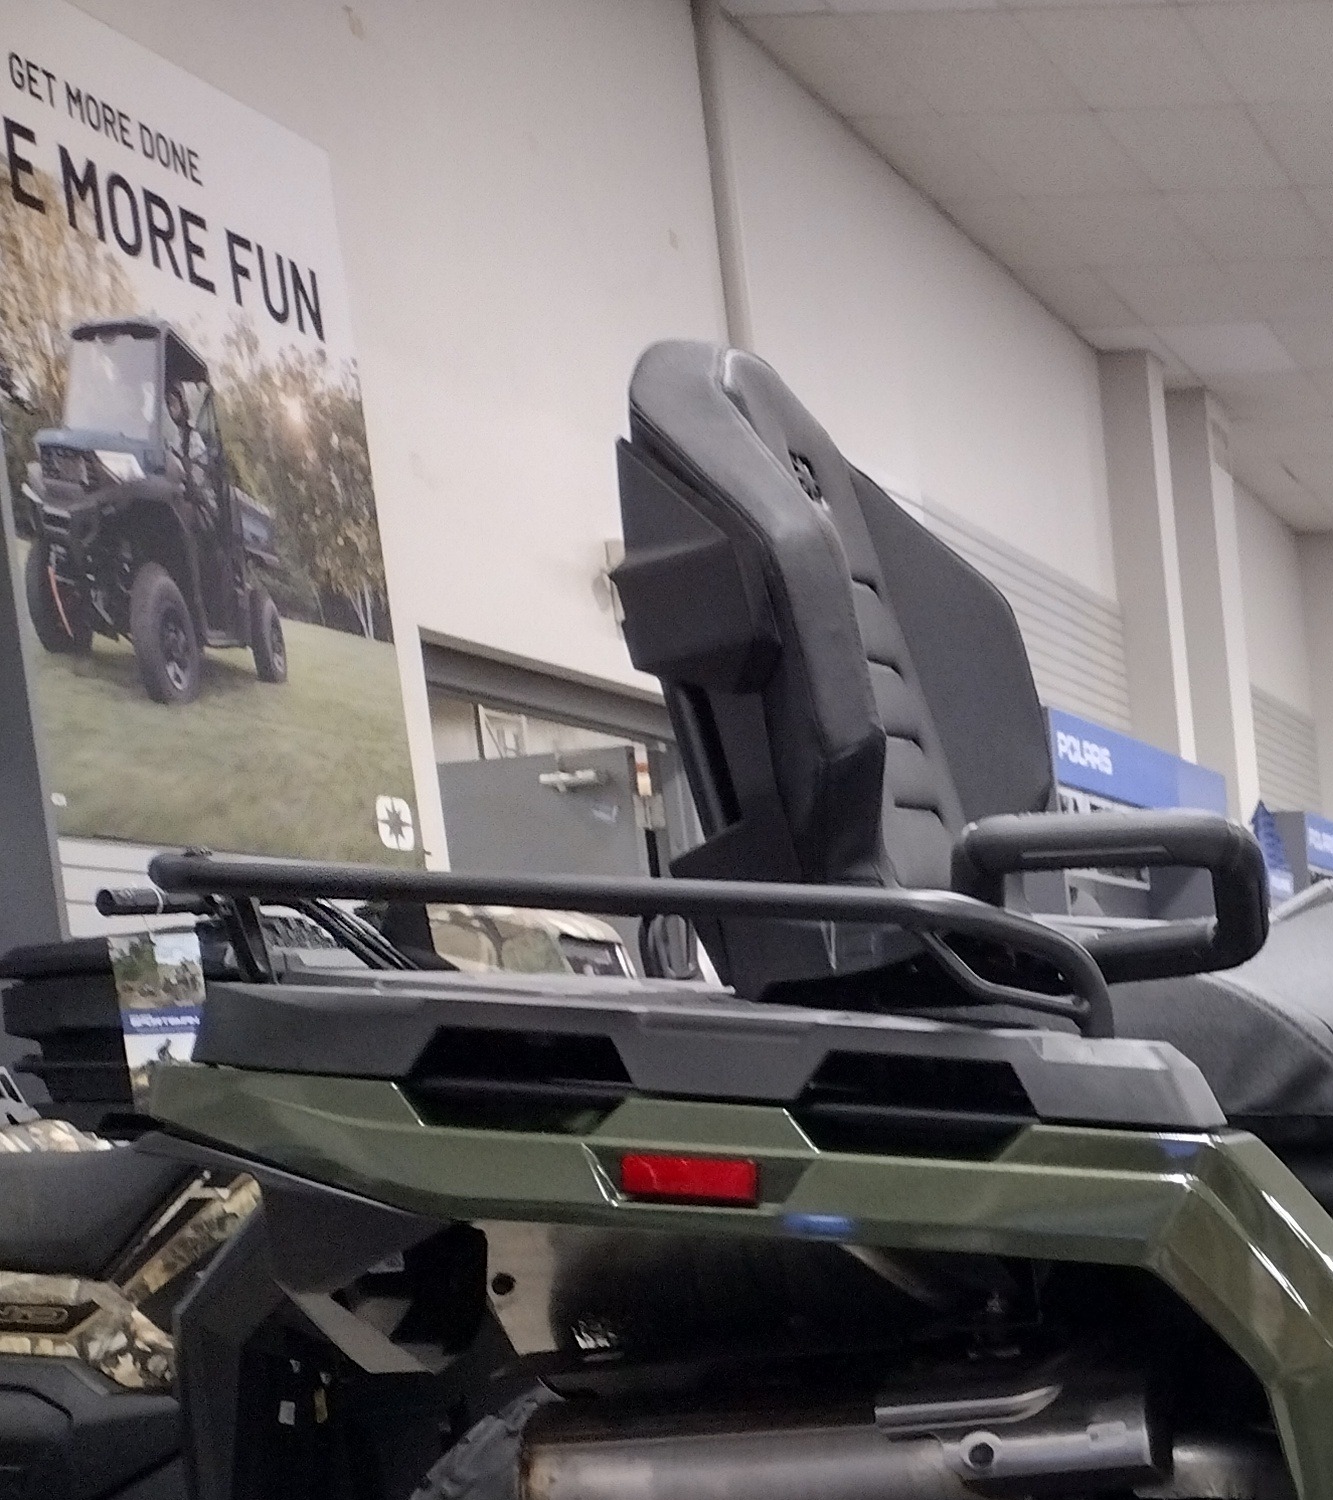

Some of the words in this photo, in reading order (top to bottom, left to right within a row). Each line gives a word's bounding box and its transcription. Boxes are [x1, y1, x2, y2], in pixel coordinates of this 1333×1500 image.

[8, 51, 57, 108] GET
[63, 81, 135, 151] MORE
[138, 120, 204, 187] DONE
[57, 142, 217, 296] MORE
[224, 227, 327, 344] FUN
